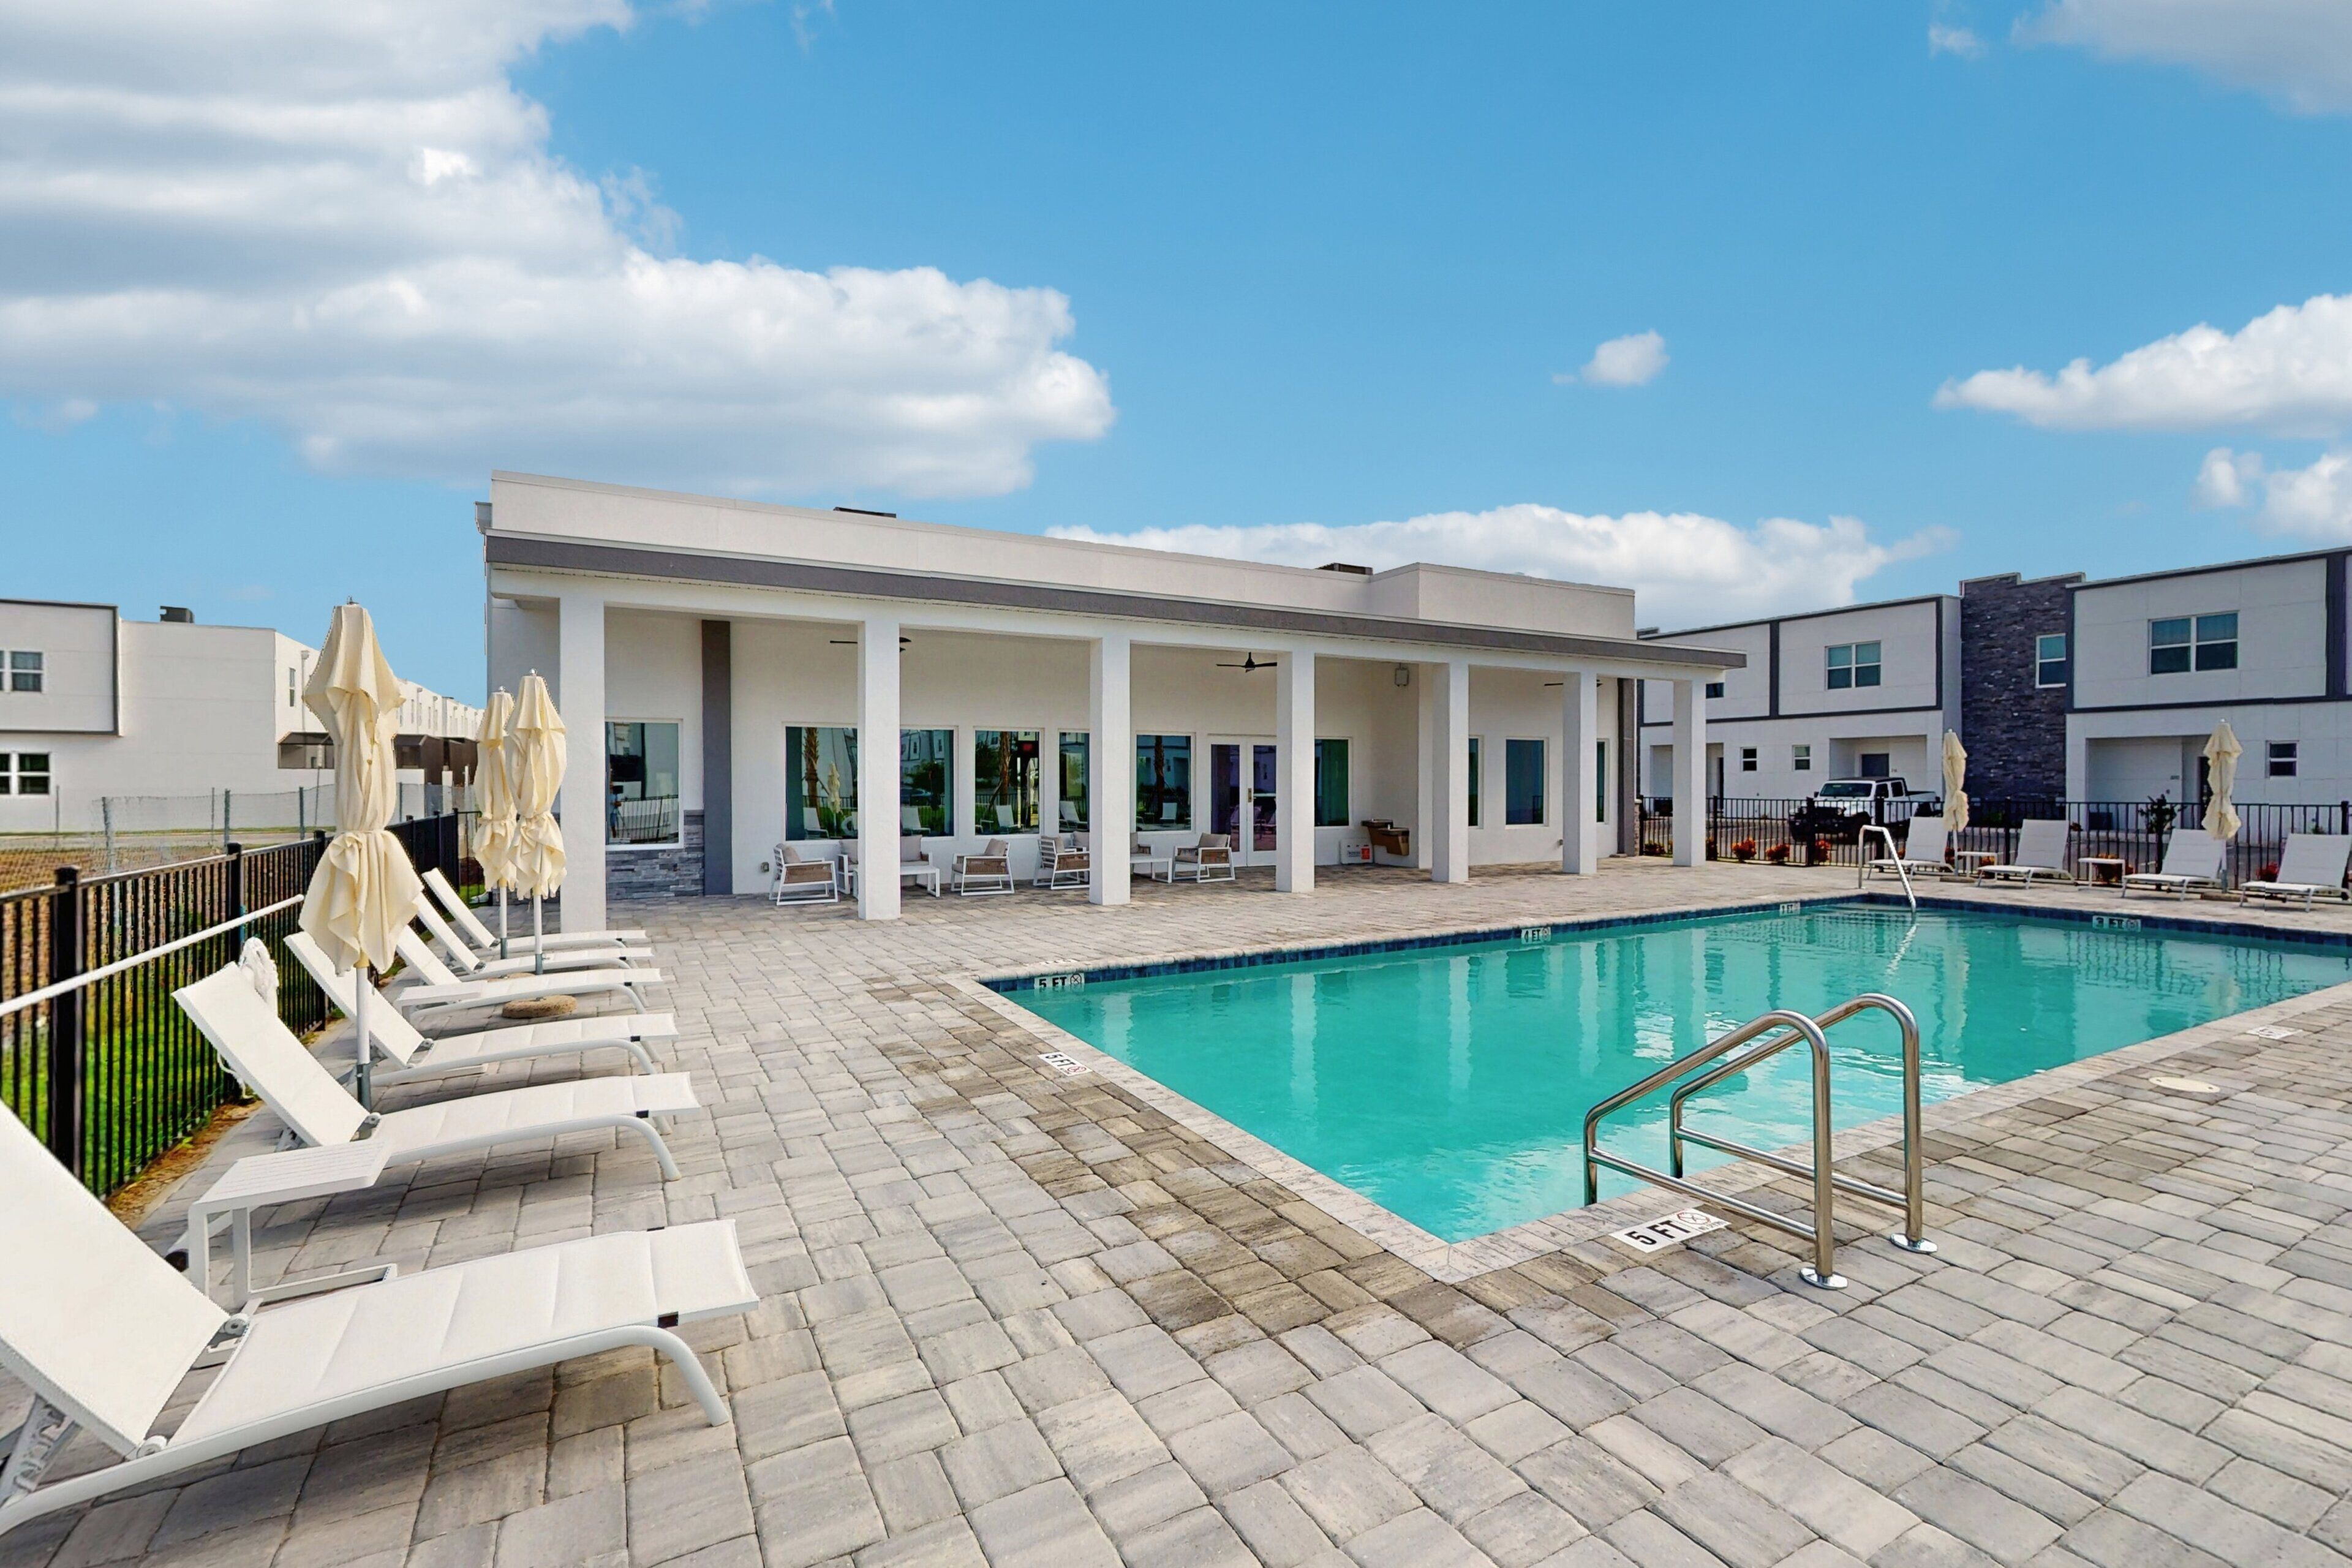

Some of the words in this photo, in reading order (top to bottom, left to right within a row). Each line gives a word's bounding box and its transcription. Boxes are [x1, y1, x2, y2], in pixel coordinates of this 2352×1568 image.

[1039, 978, 1047, 988] 5
[1052, 976, 1067, 987] FT
[1051, 1058, 1076, 1067] FT
[1624, 1231, 1657, 1246] 5
[1646, 1219, 1691, 1240] FT
